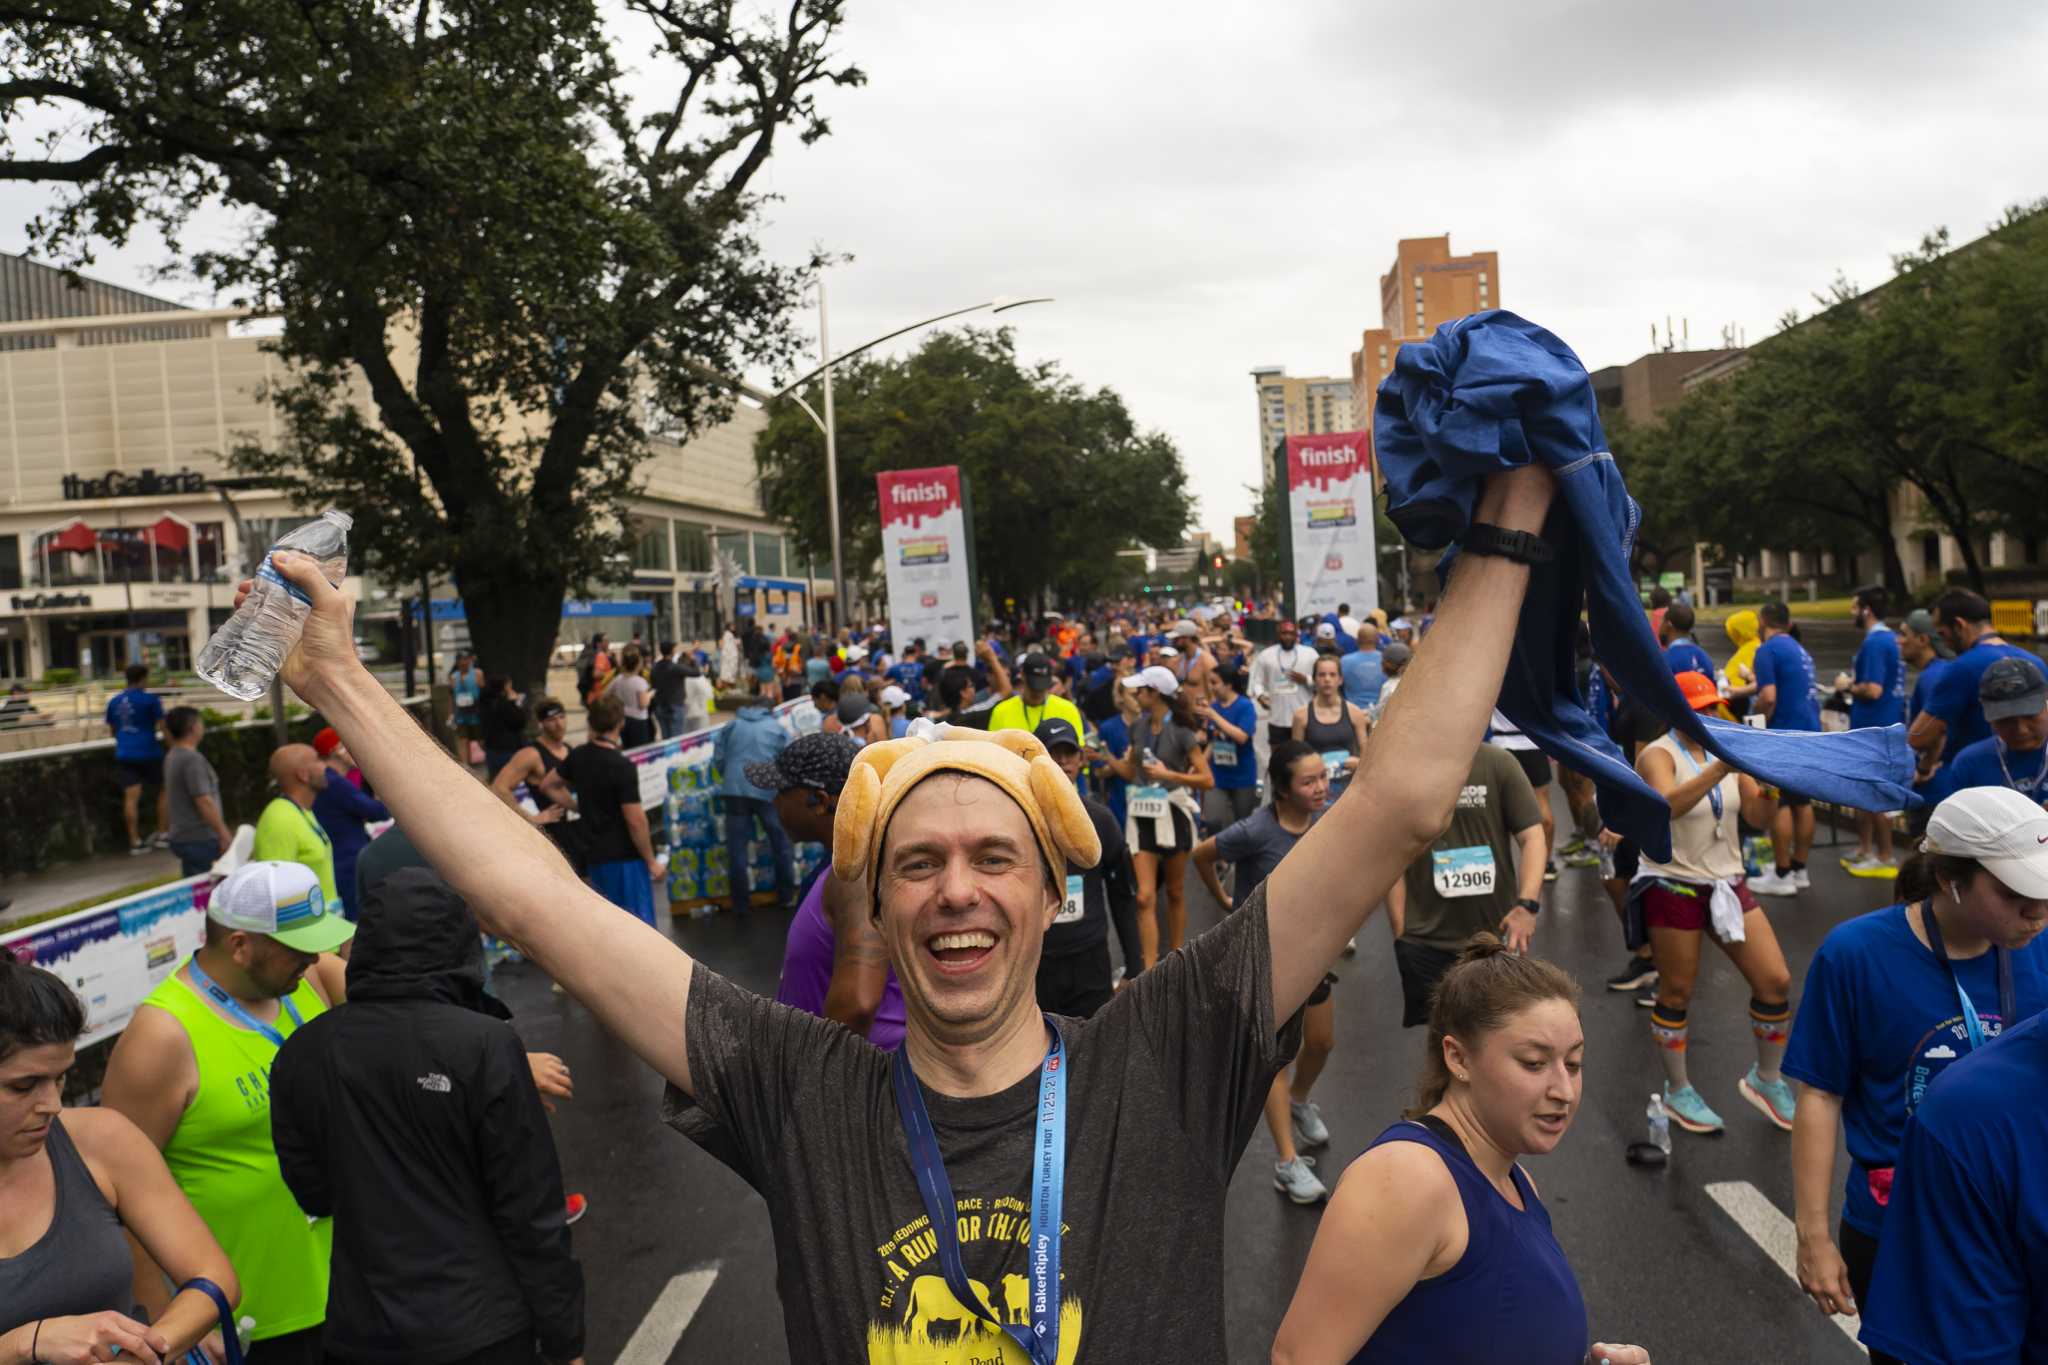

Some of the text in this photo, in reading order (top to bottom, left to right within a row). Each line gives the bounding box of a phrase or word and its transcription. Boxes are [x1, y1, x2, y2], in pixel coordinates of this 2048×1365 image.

[1299, 445, 1358, 467] finish
[891, 481, 949, 504] finish
[1442, 871, 1492, 889] 12906
[1040, 1075, 1058, 1228] HOUSTON TURKEY TROT 11.25.21
[957, 1198, 983, 1212] RACE
[887, 1260, 910, 1282] A
[900, 1227, 938, 1267] RUN
[957, 1215, 981, 1243] OR
[1034, 1234, 1050, 1313] BakerRipley
